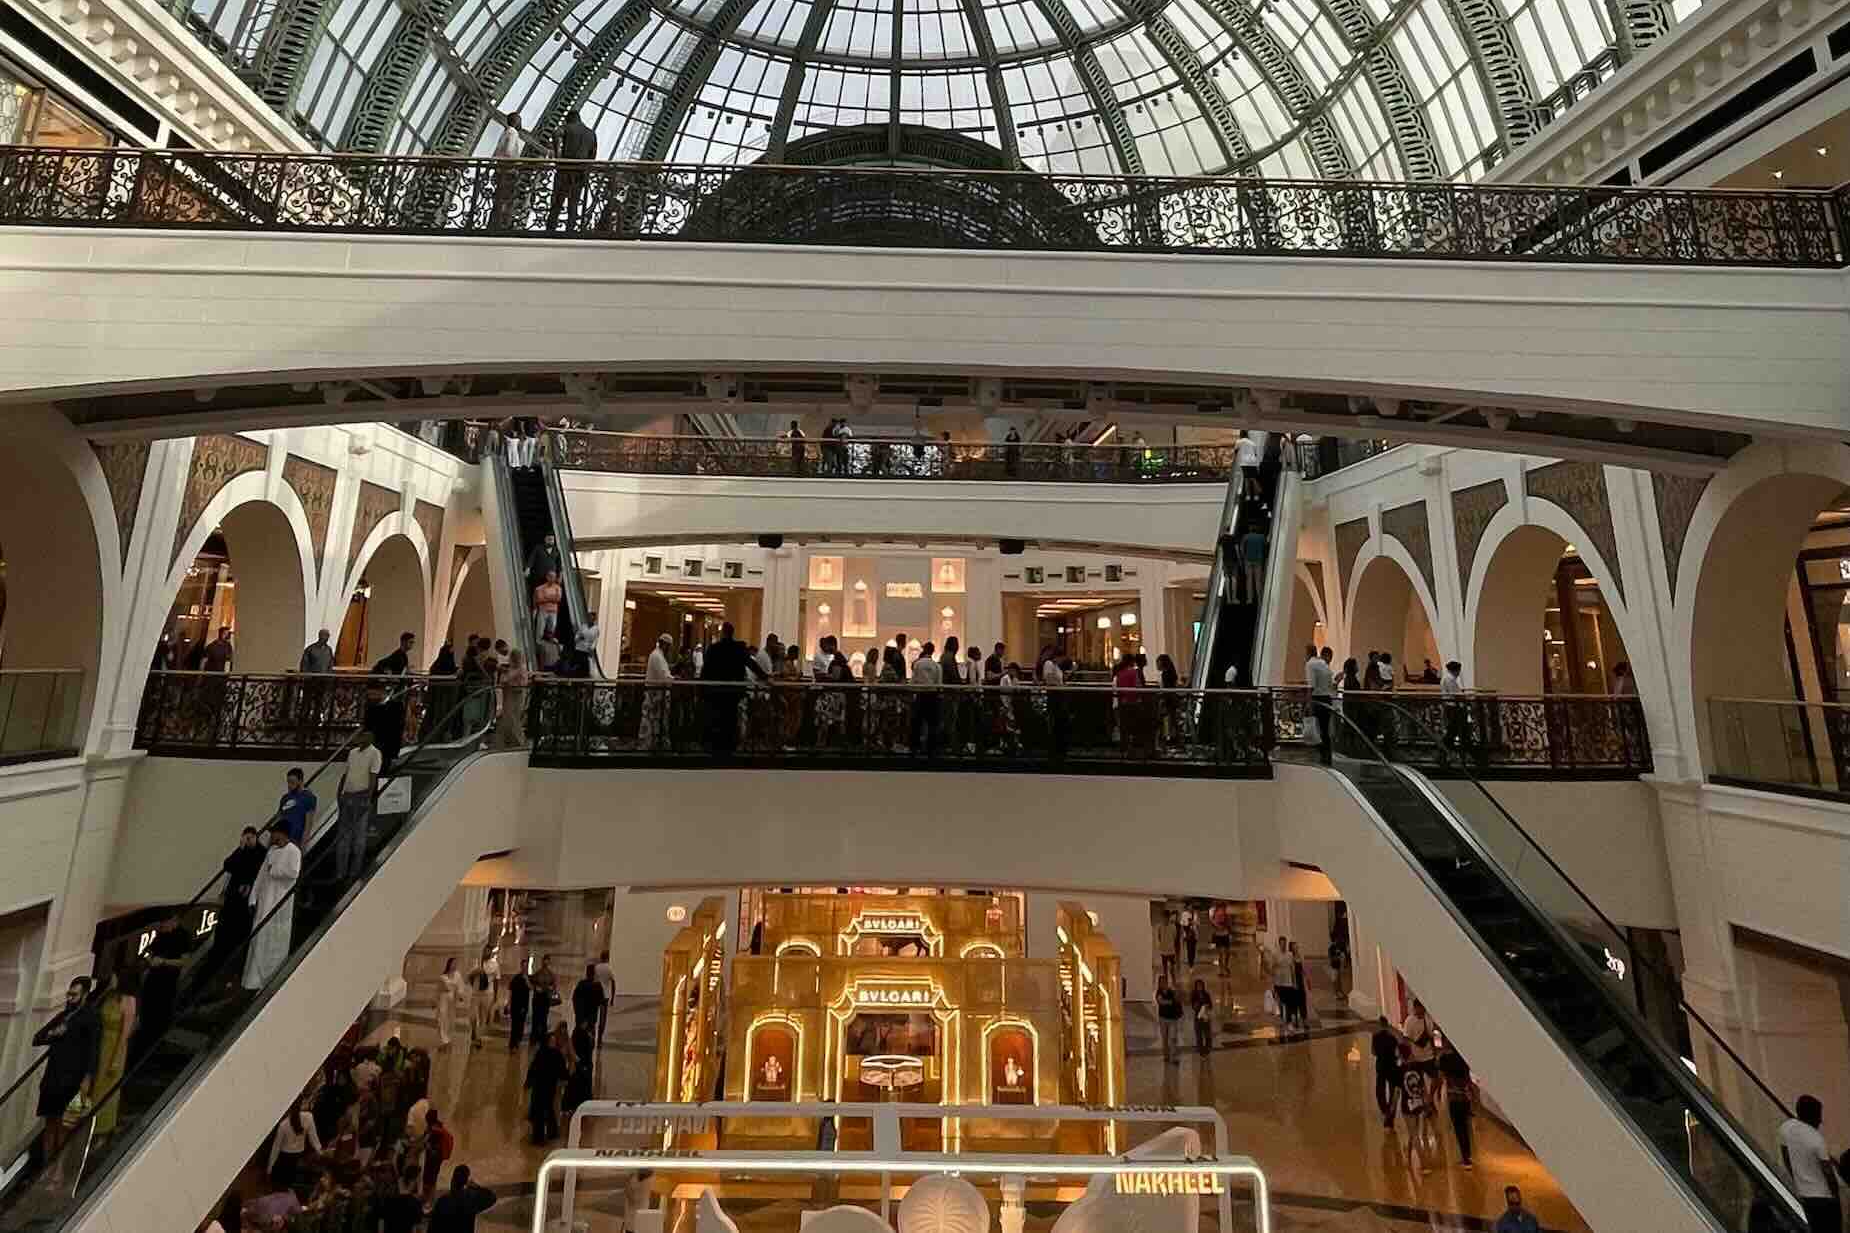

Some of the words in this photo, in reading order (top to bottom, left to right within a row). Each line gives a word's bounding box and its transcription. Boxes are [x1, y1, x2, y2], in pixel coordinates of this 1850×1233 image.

[863, 919, 919, 930] BVLGARI
[859, 989, 929, 1002] BVLGARI
[1115, 1172, 1225, 1196] NAKHEEL
